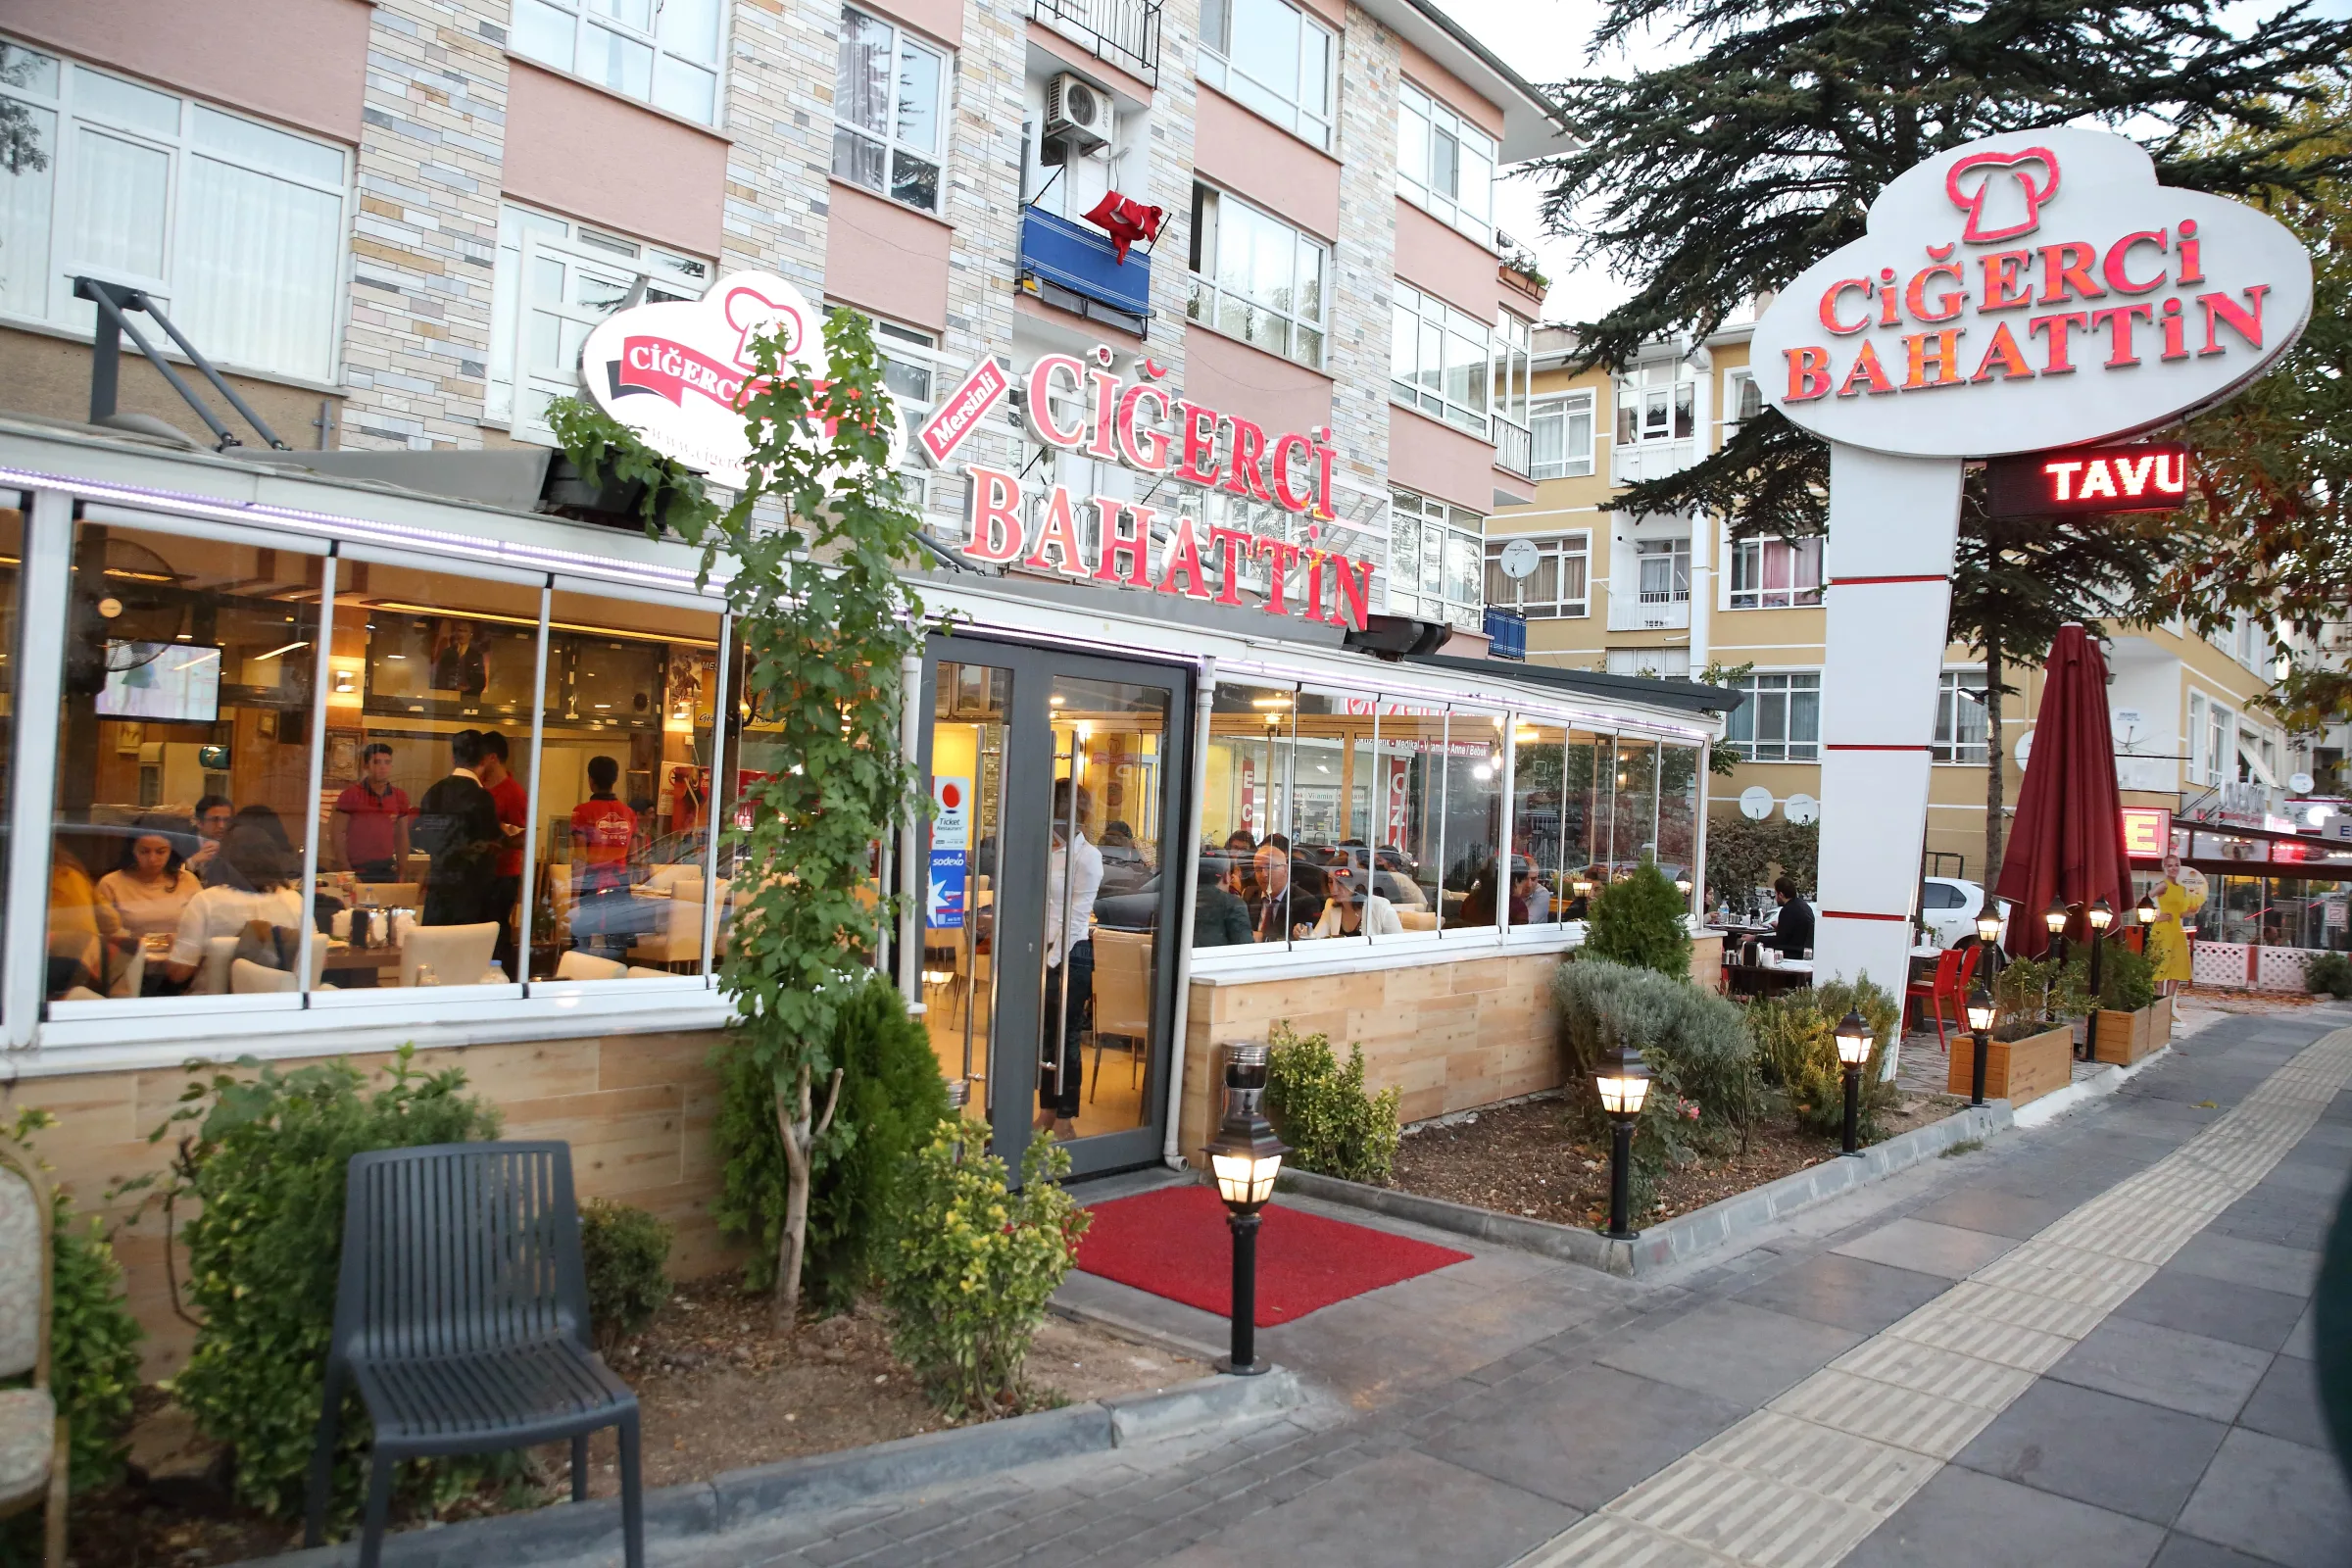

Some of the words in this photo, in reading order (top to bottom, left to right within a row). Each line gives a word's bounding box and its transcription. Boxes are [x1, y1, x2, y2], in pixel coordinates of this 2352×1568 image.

[930, 370, 1000, 450] Mersinli
[2045, 453, 2184, 501] TAVU
[939, 817, 960, 826] Ticket
[932, 853, 964, 866] sodexo
